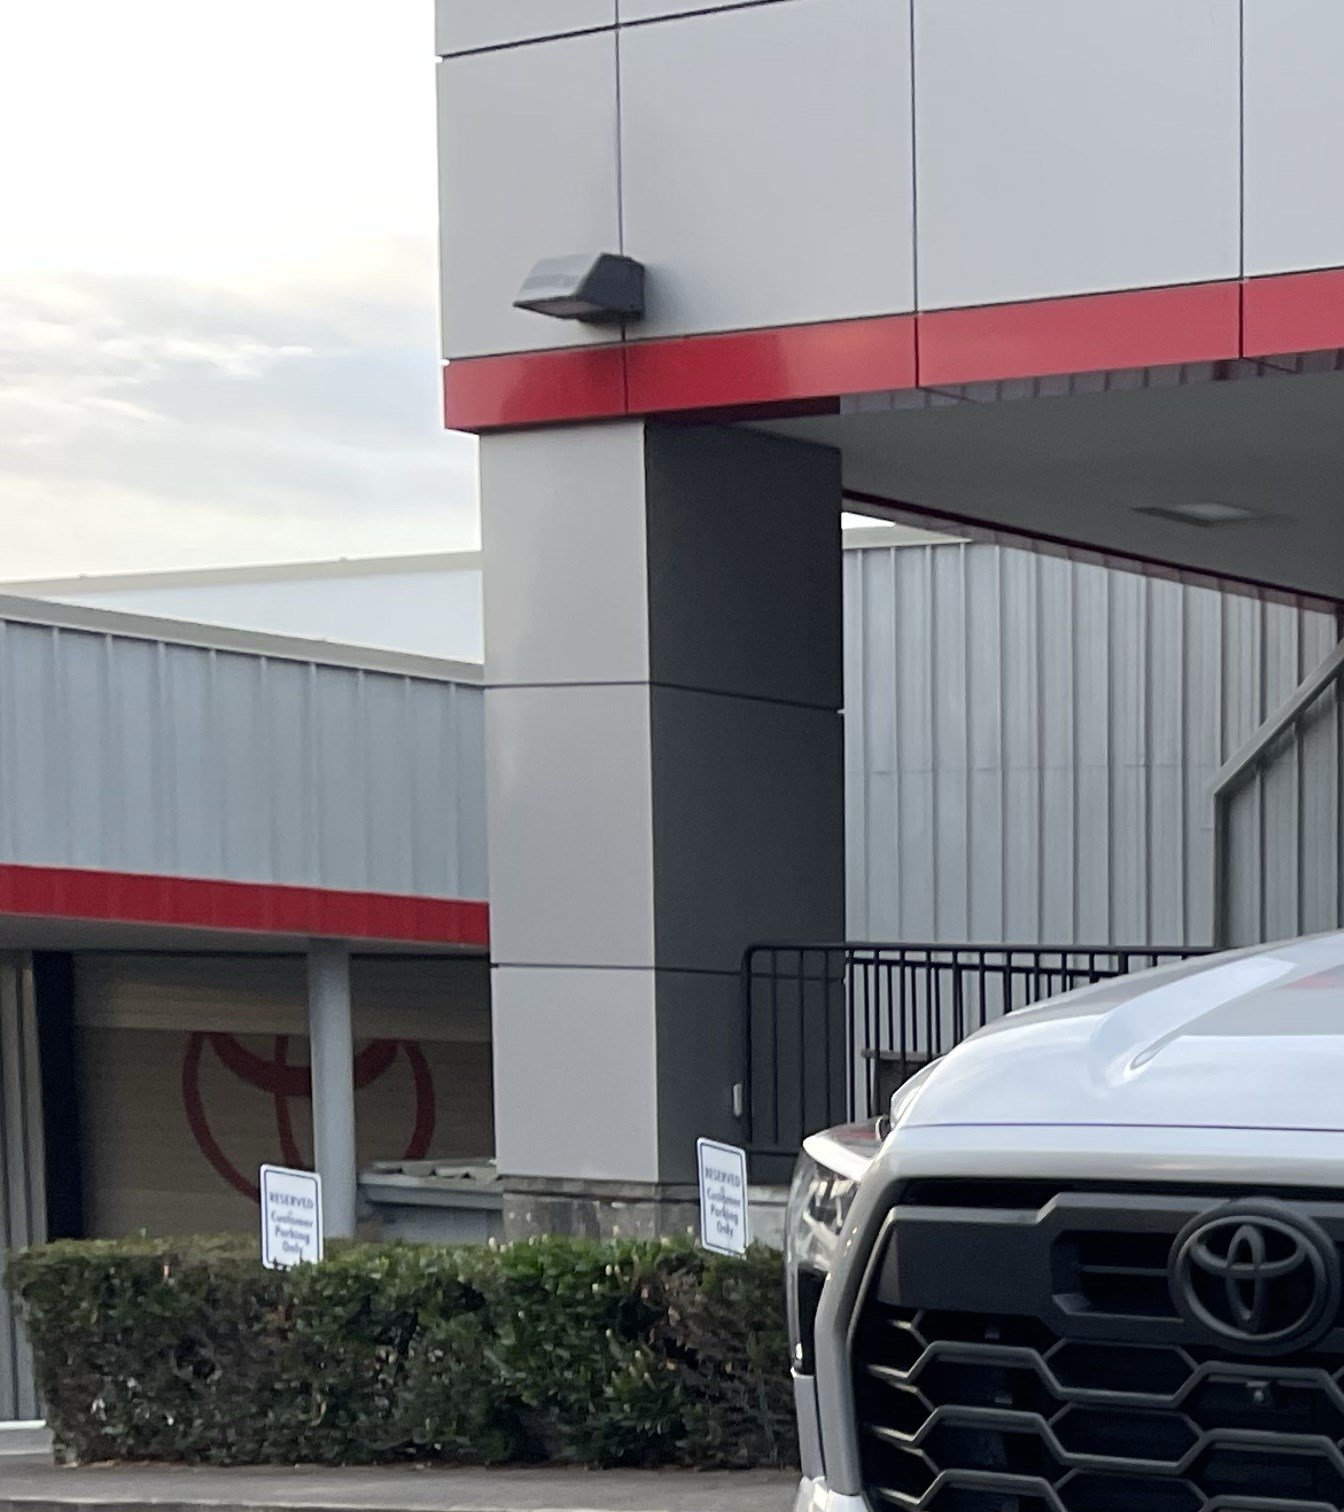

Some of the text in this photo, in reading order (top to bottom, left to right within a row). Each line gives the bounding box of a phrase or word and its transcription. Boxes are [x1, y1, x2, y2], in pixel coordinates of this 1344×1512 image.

[705, 1167, 740, 1188] RESERVED
[270, 1192, 313, 1209] RESERVED
[274, 1224, 310, 1246] Parking
